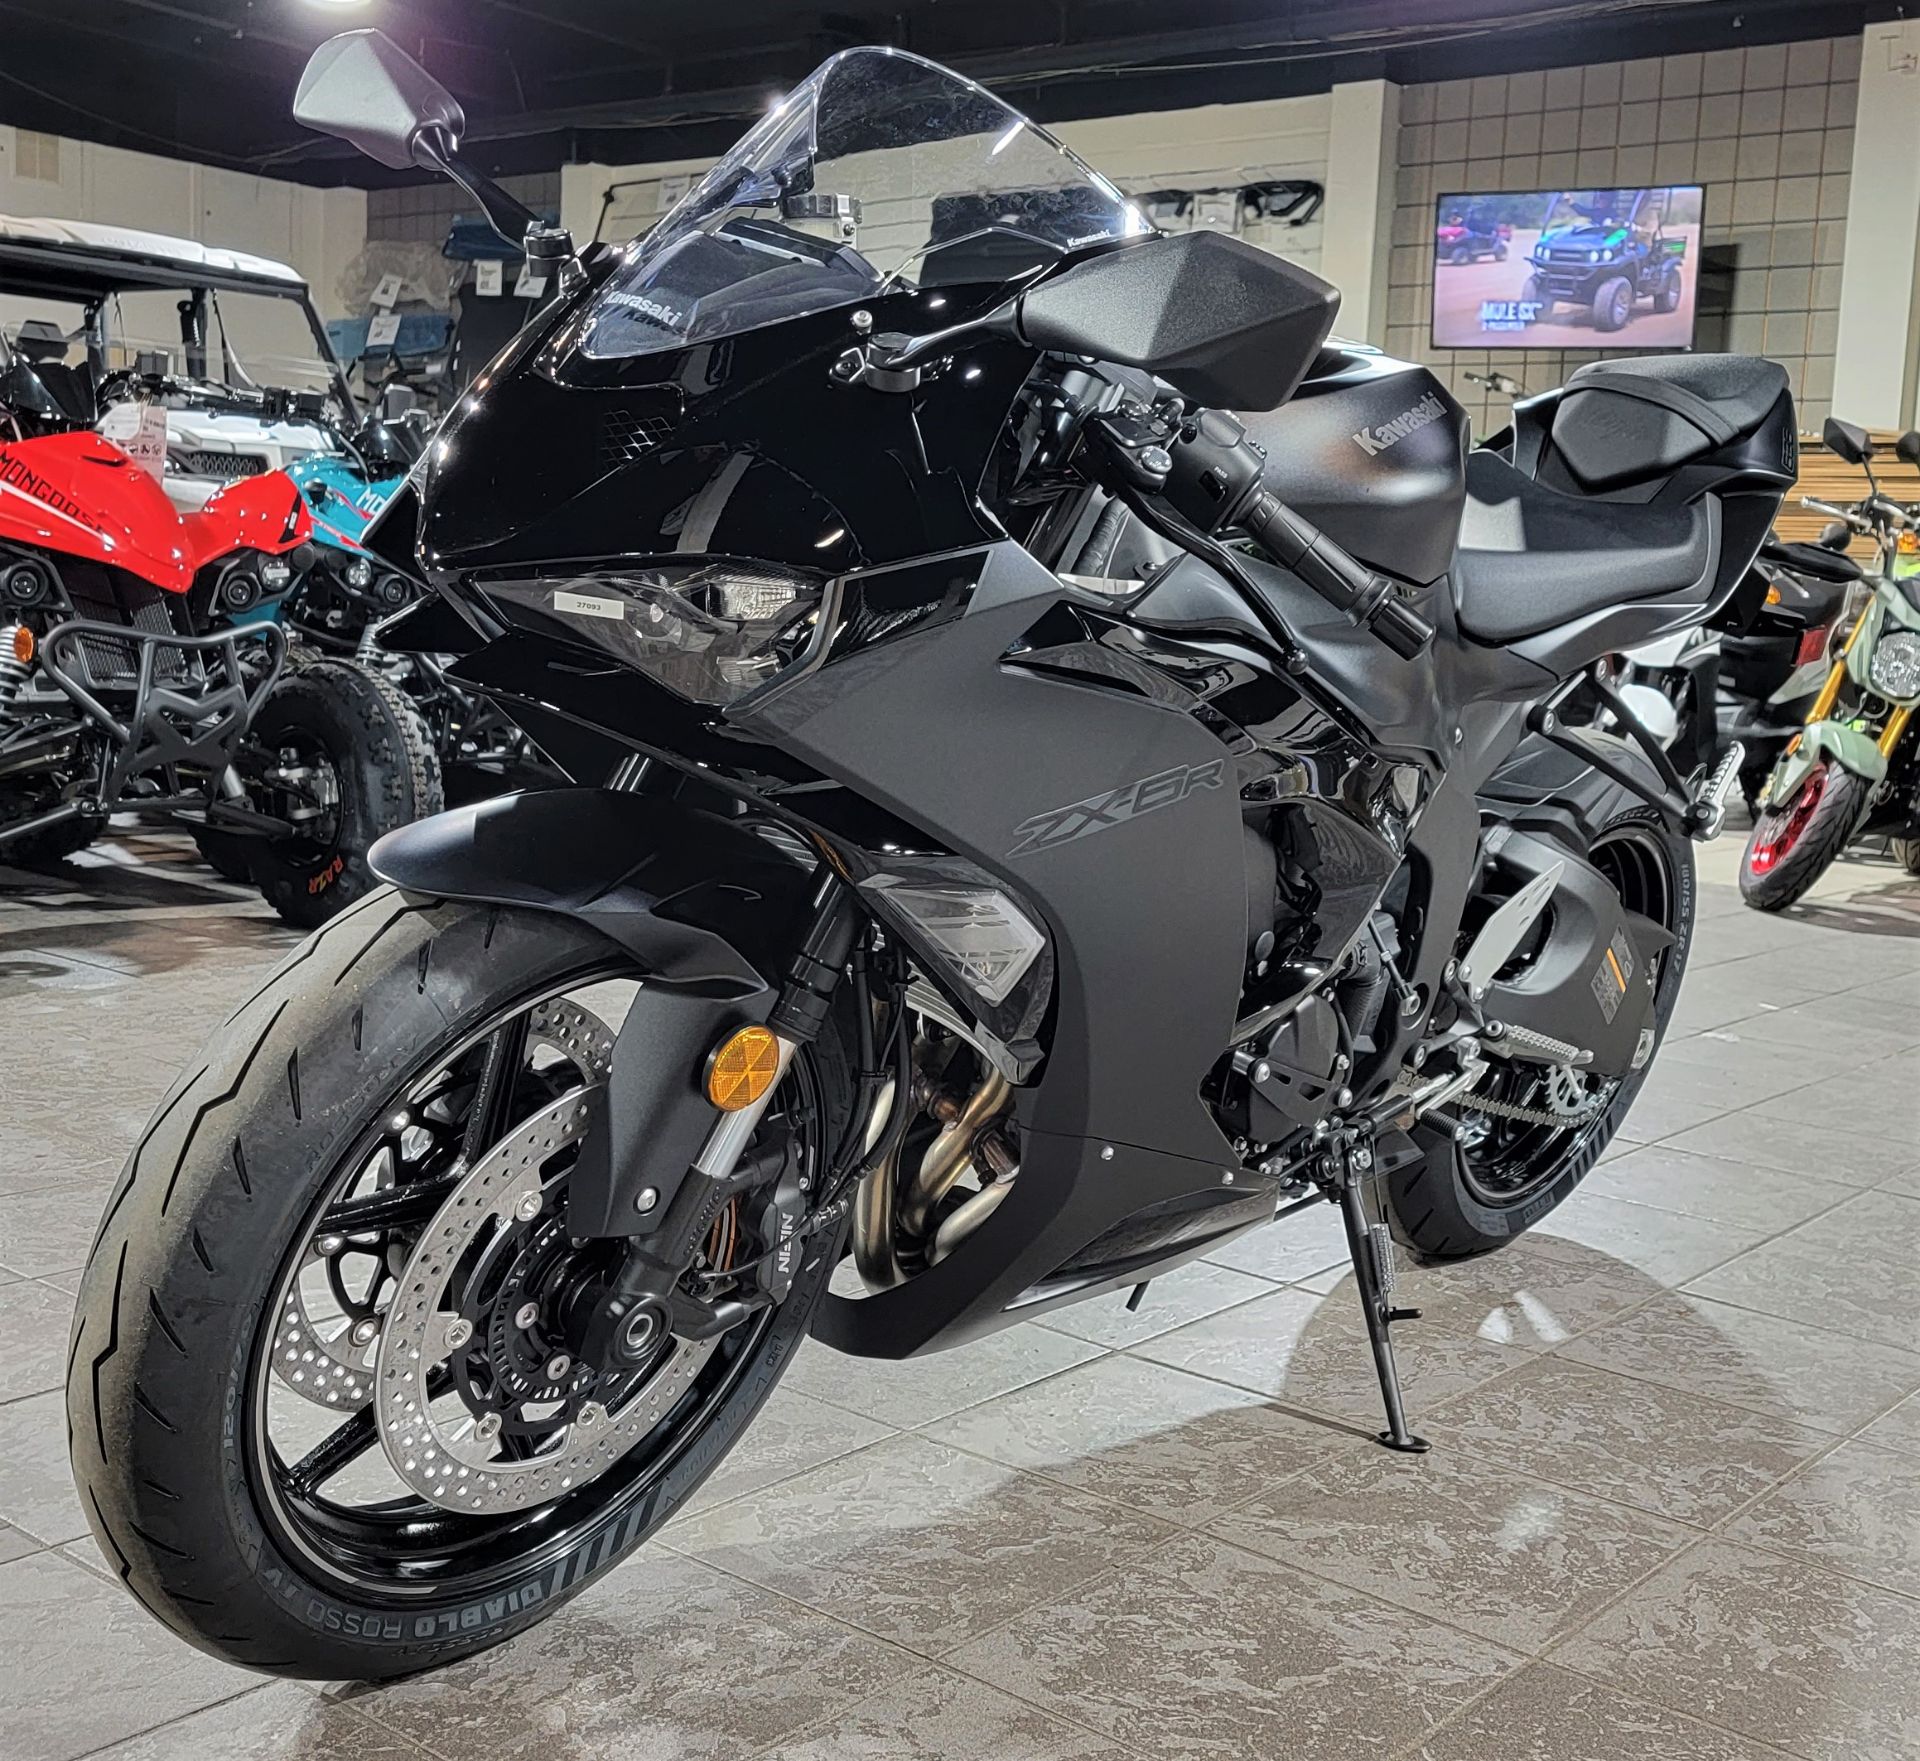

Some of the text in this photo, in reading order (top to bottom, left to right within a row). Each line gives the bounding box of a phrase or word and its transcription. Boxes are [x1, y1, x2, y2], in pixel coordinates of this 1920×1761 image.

[1066, 228, 1110, 247] Kawasaki
[602, 290, 682, 327] Kawasaki
[1352, 391, 1448, 456] Kawasaki
[1005, 758, 1224, 860] ZX-6R
[308, 854, 344, 894] RAZR
[306, 1601, 401, 1639] ROSSO
[414, 1579, 544, 1638] DIABLO
